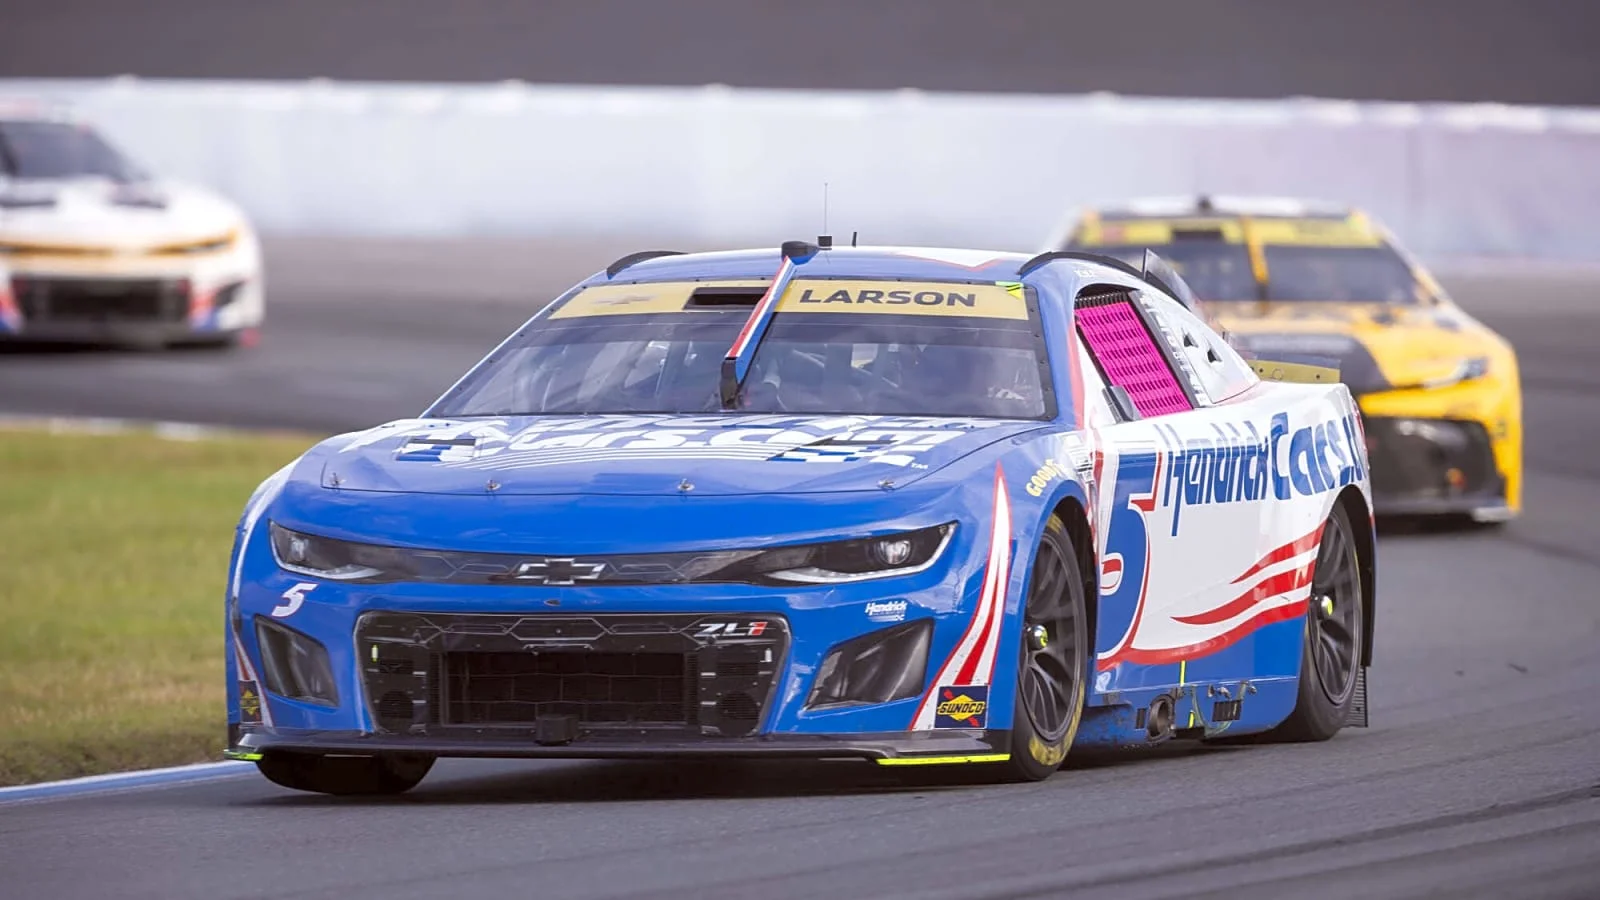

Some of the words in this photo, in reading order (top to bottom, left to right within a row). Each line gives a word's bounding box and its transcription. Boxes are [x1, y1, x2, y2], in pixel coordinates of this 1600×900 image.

[800, 289, 976, 307] LARSON
[1096, 452, 1161, 662] 5
[271, 583, 319, 618] 5
[939, 702, 984, 714] SUNOCO
